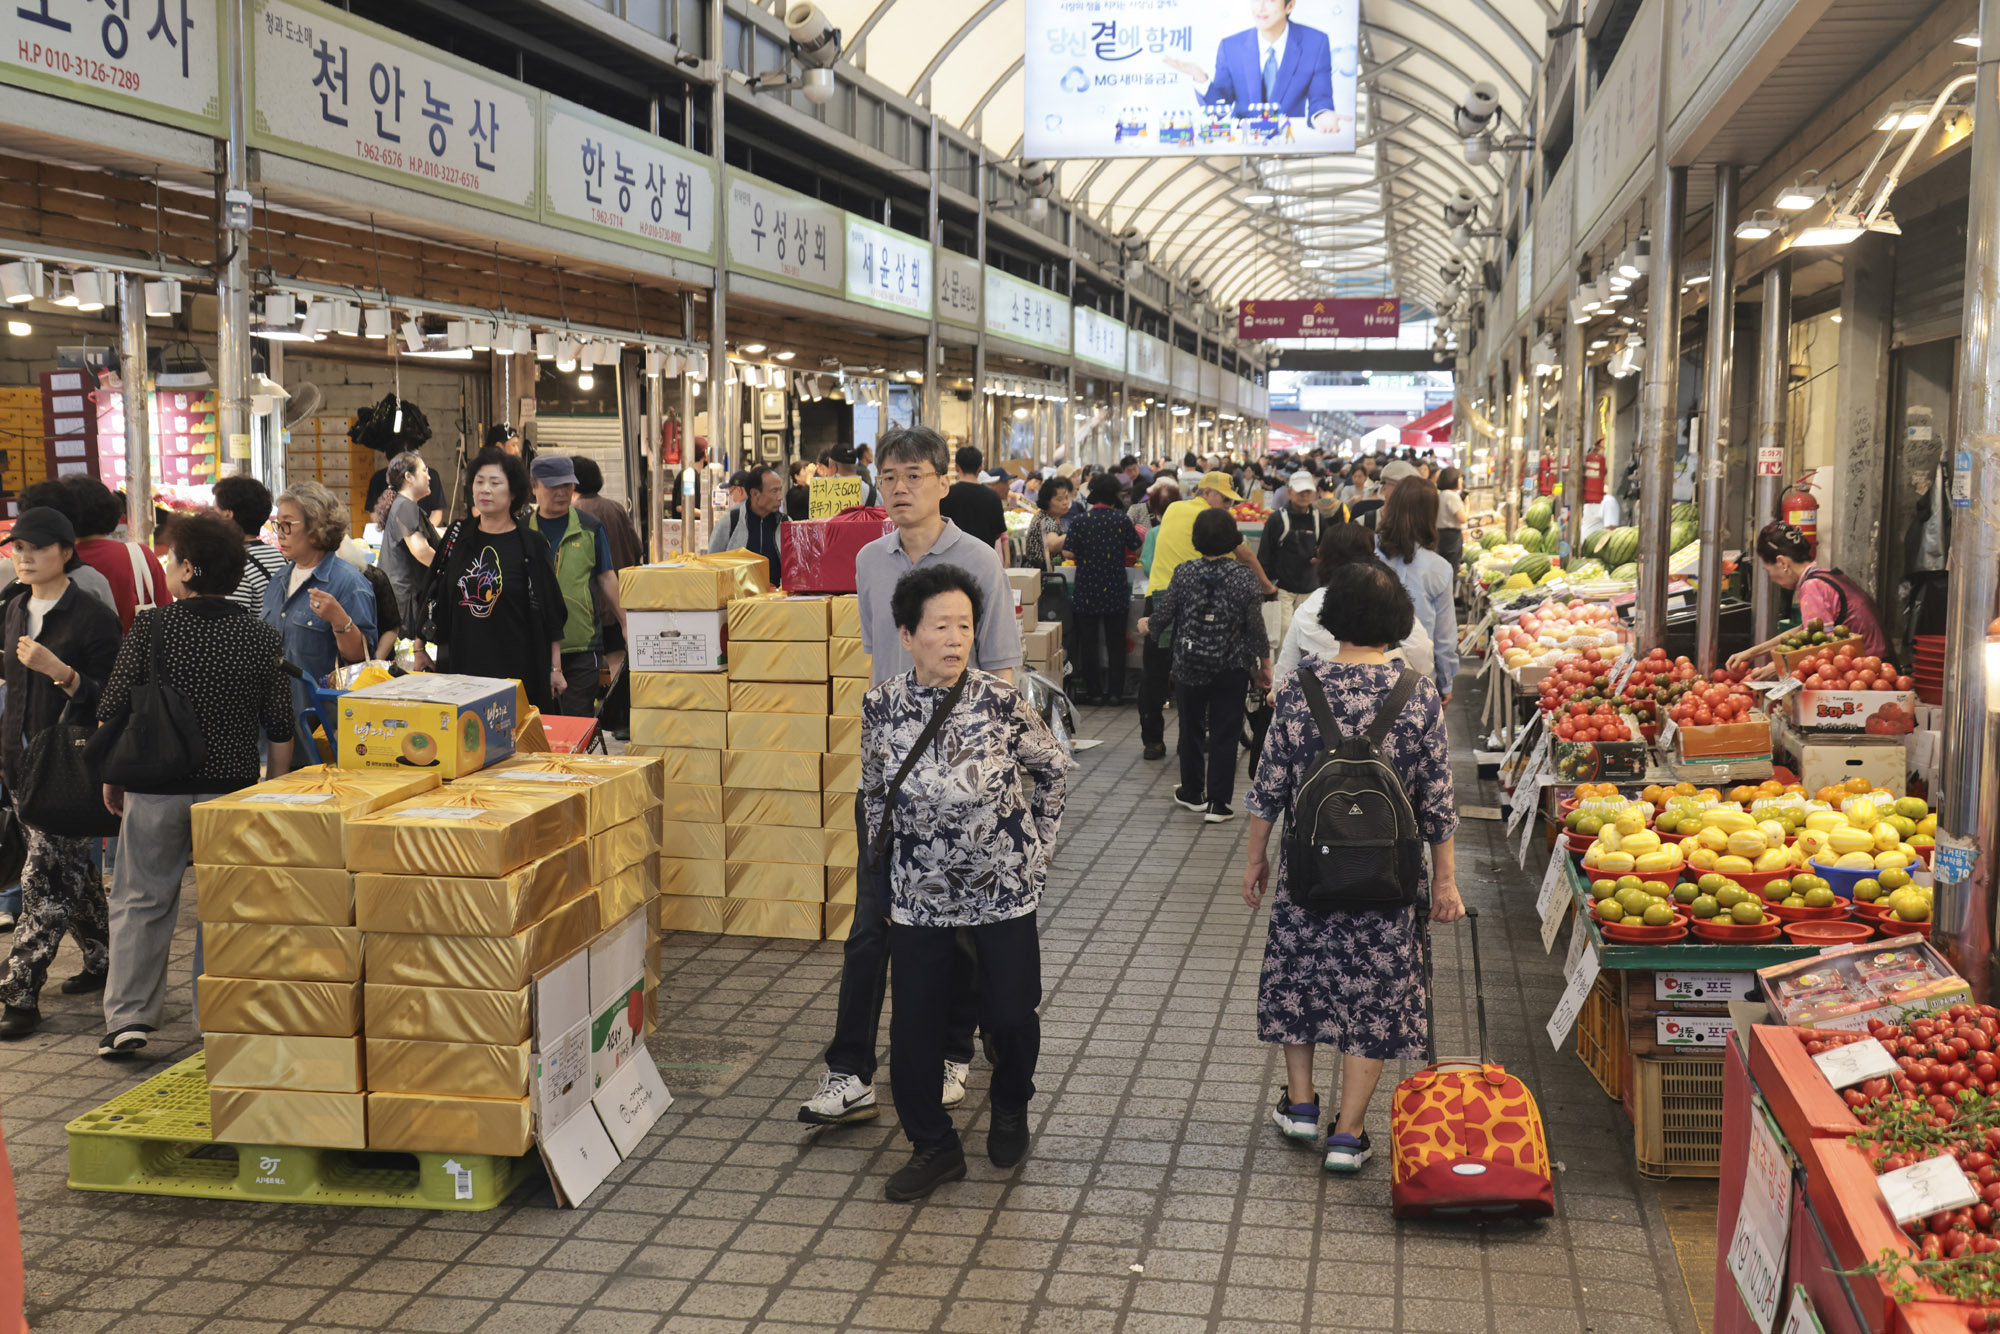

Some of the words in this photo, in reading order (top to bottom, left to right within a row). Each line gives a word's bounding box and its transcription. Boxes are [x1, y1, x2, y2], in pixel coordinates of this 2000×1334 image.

[1047, 27, 1087, 57] 당신
[1091, 20, 1143, 61] 곁에
[1145, 25, 1192, 53] 함께
[18, 39, 41, 63] H.P
[45, 47, 140, 92] 010-3126-7289
[311, 38, 500, 173] 천안농산
[356, 140, 403, 168] T.962-6576
[409, 155, 480, 190] H.P.010-3227-6576
[580, 137, 692, 231] 한농상회
[592, 207, 623, 229] T.962-5714
[751, 201, 827, 271] 우성상회
[1816, 701, 1855, 719] 토마토
[1942, 855, 1963, 866] 부작용
[1706, 981, 1732, 993] 포도
